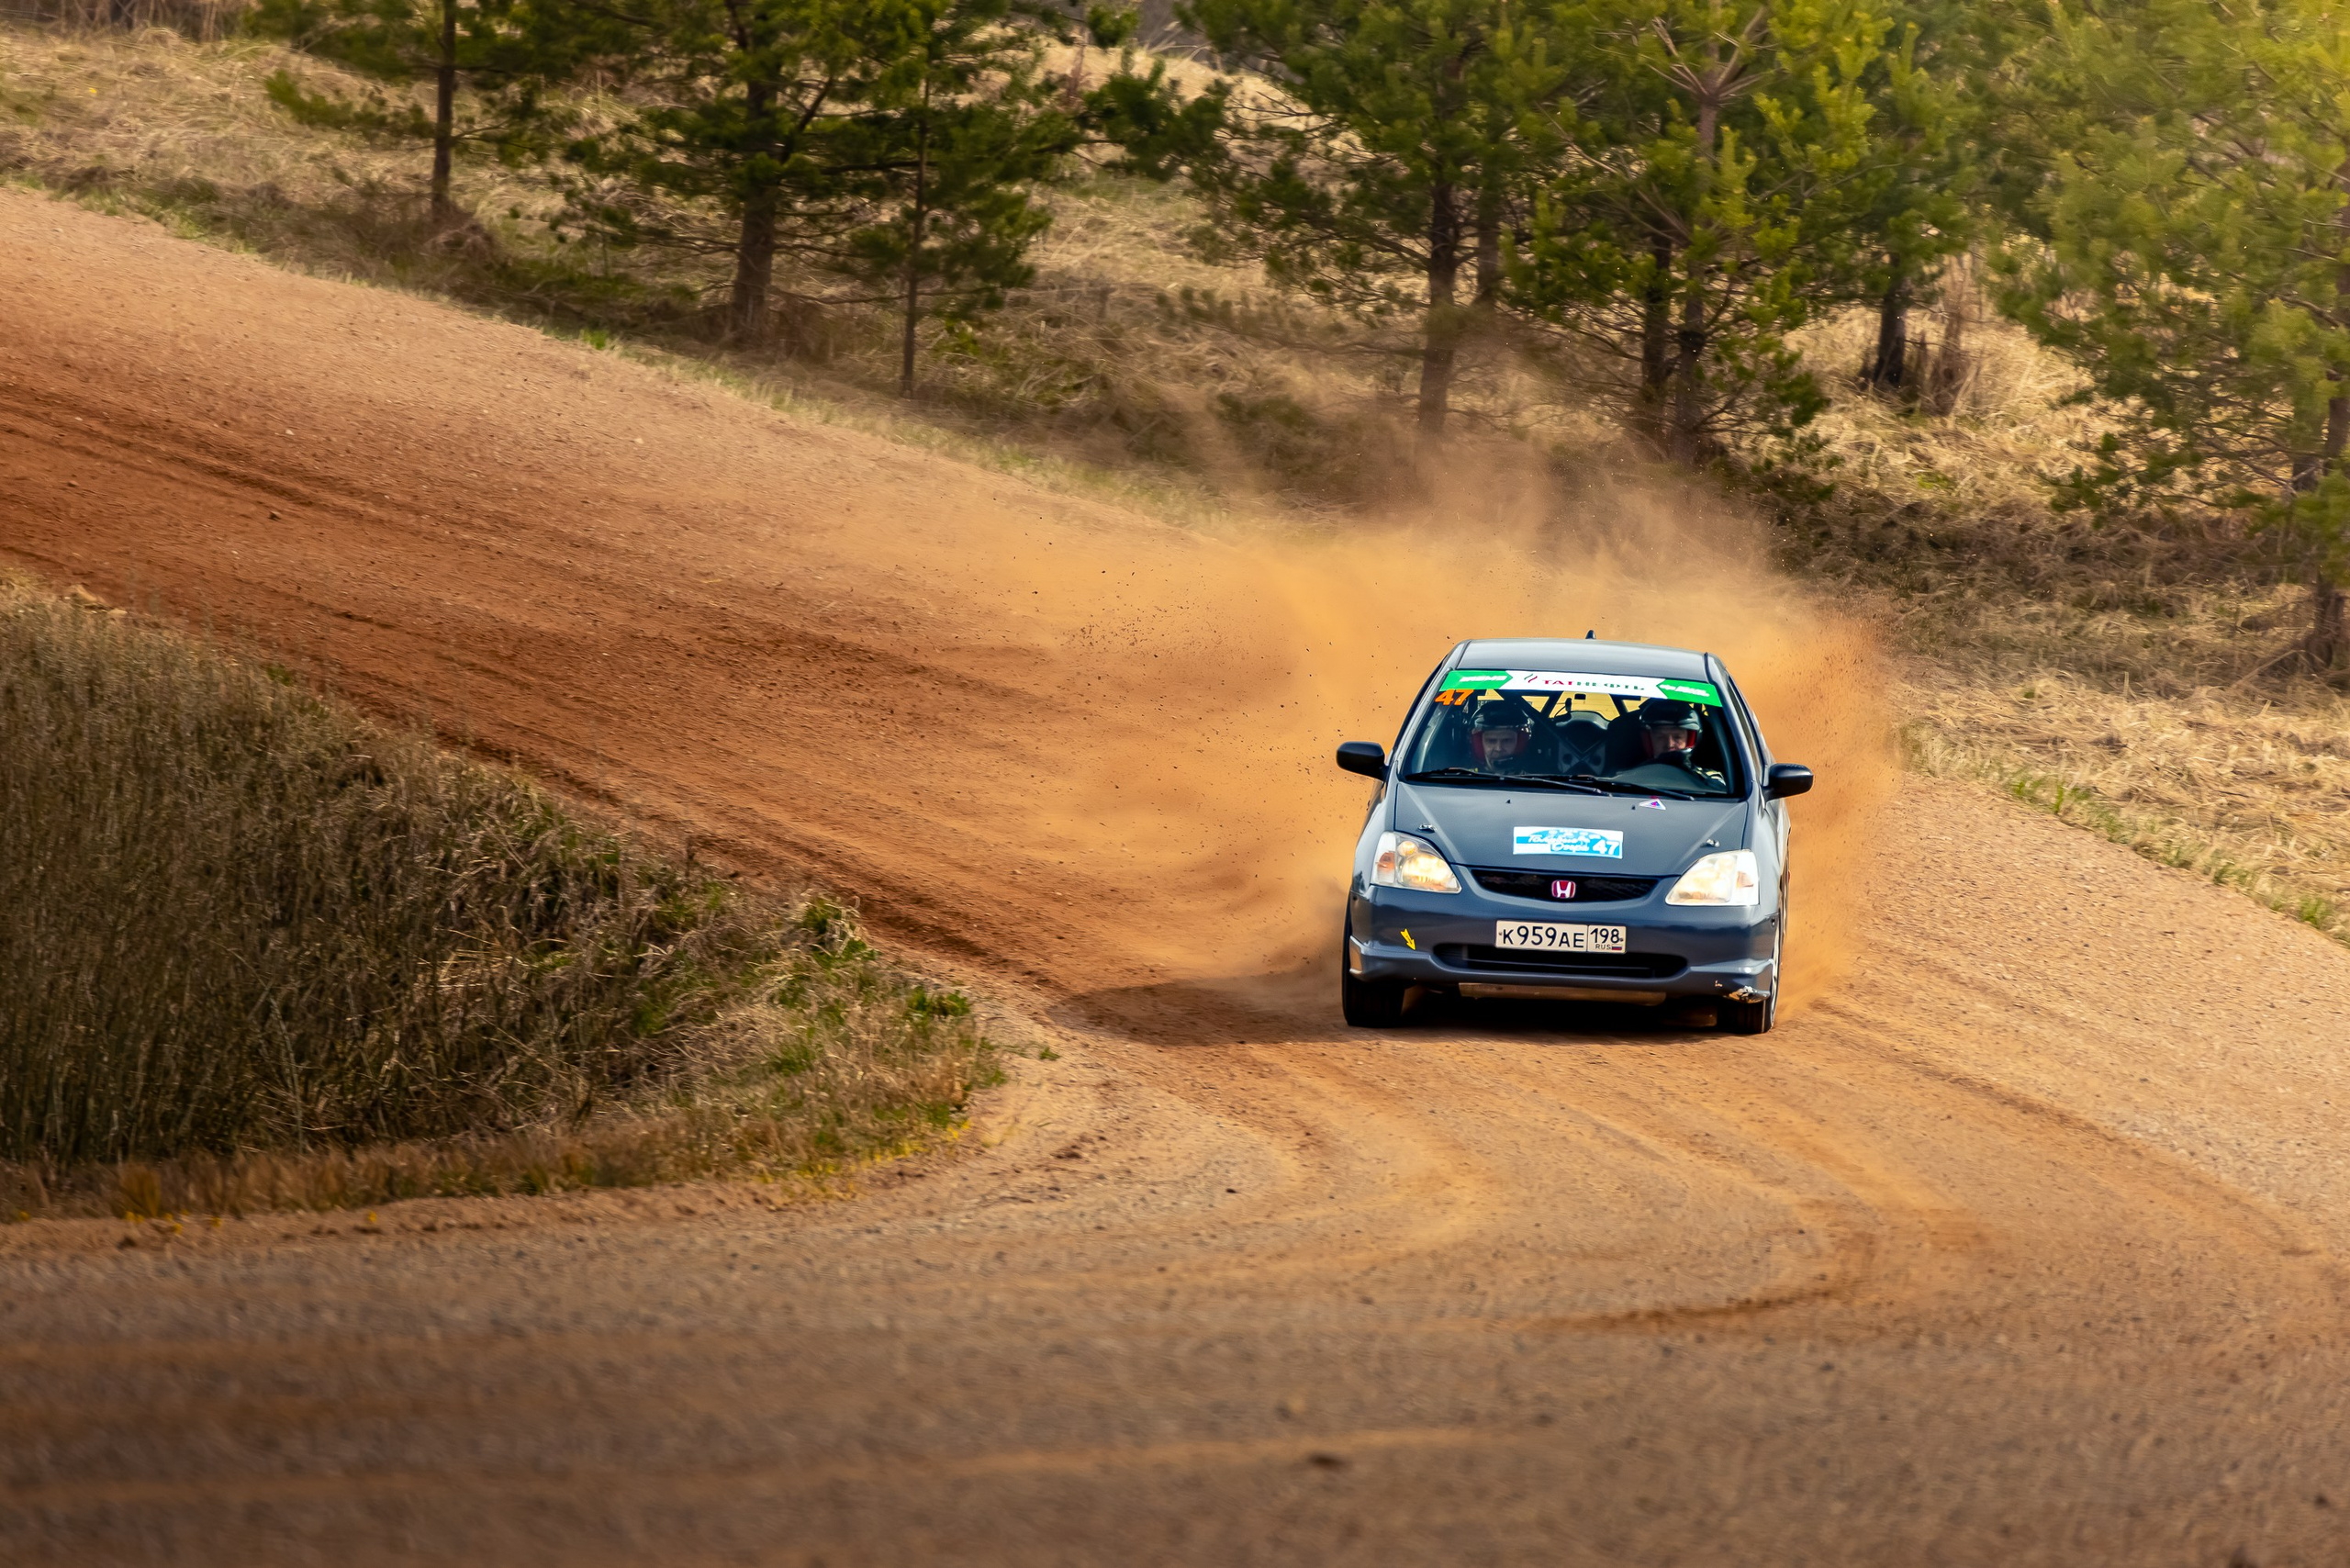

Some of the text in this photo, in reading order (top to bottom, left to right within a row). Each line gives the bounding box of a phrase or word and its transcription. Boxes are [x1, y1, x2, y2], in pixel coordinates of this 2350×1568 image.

[1434, 689, 1474, 706] 47
[1593, 839, 1619, 855] 47
[1590, 928, 1619, 944] 198
